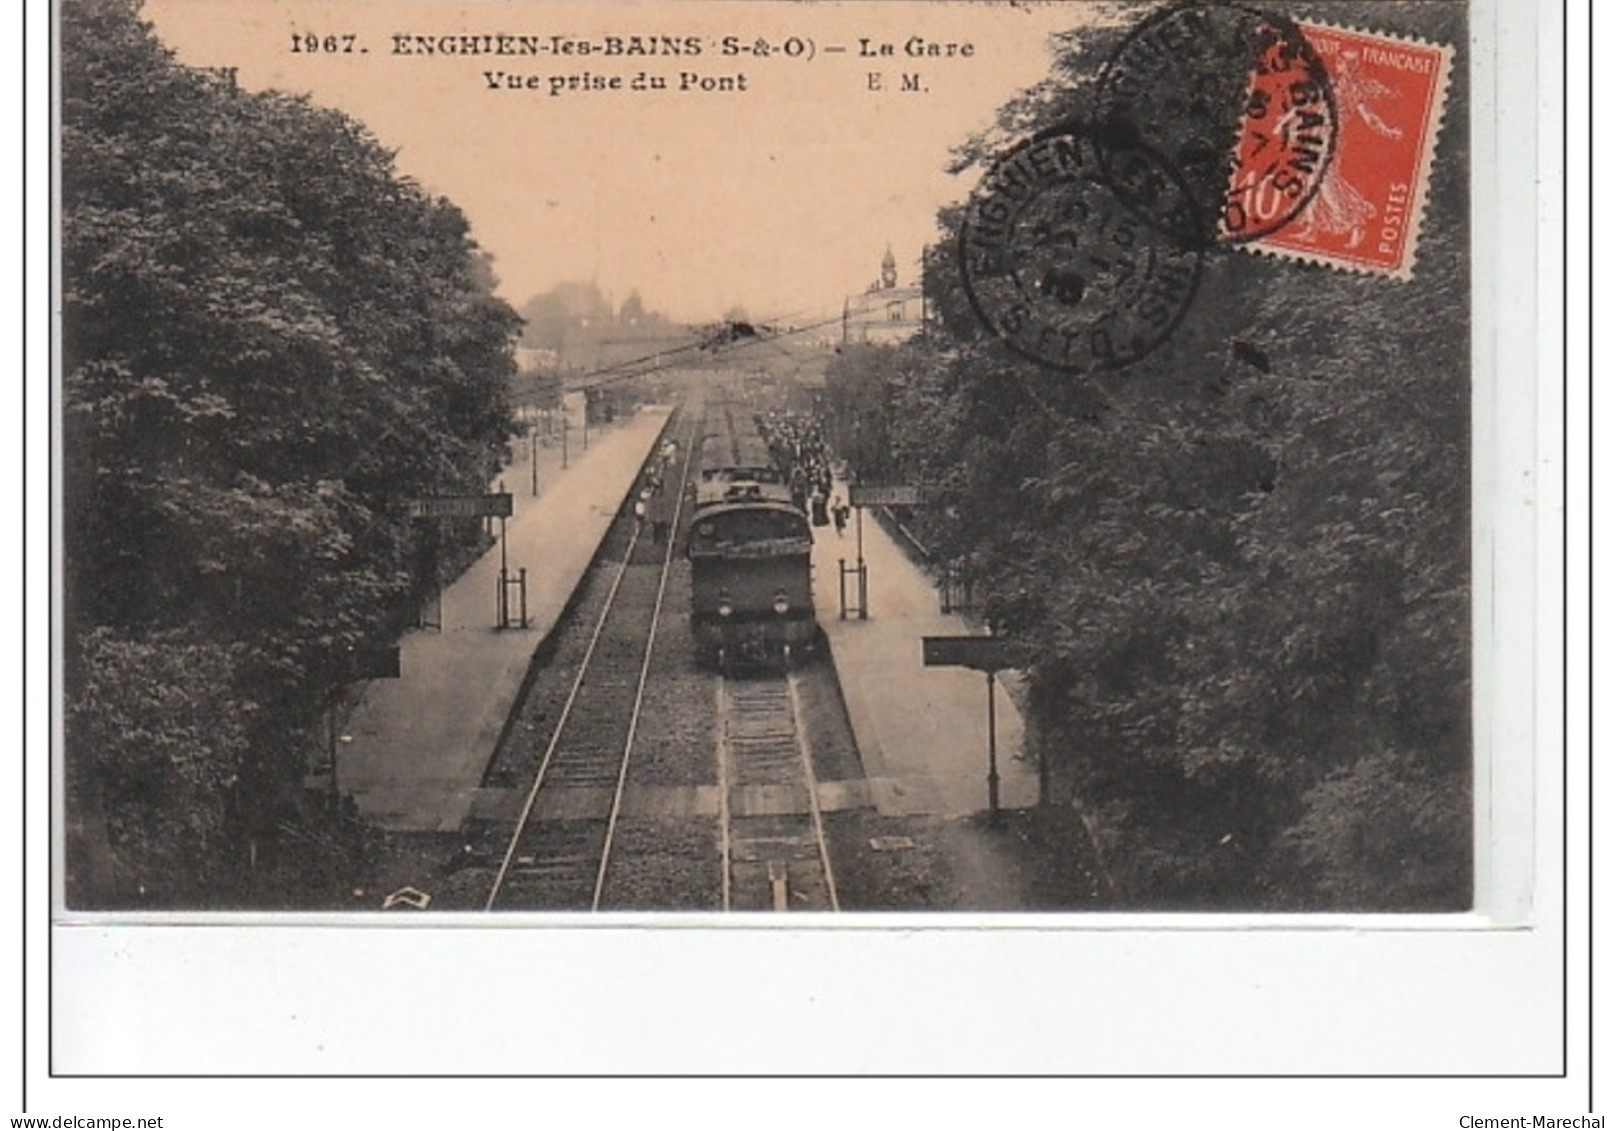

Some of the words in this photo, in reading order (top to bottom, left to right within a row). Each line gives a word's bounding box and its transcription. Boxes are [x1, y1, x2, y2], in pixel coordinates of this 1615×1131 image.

[290, 32, 369, 54] 1967.
[859, 38, 894, 57] La
[904, 36, 974, 57] Gare
[483, 71, 539, 89] Vue
[548, 72, 621, 96] prise
[631, 72, 667, 91] du
[679, 72, 746, 91] Pont
[901, 73, 929, 92] M.
[1238, 171, 1281, 220] 10
[1379, 183, 1407, 254] POSTES
